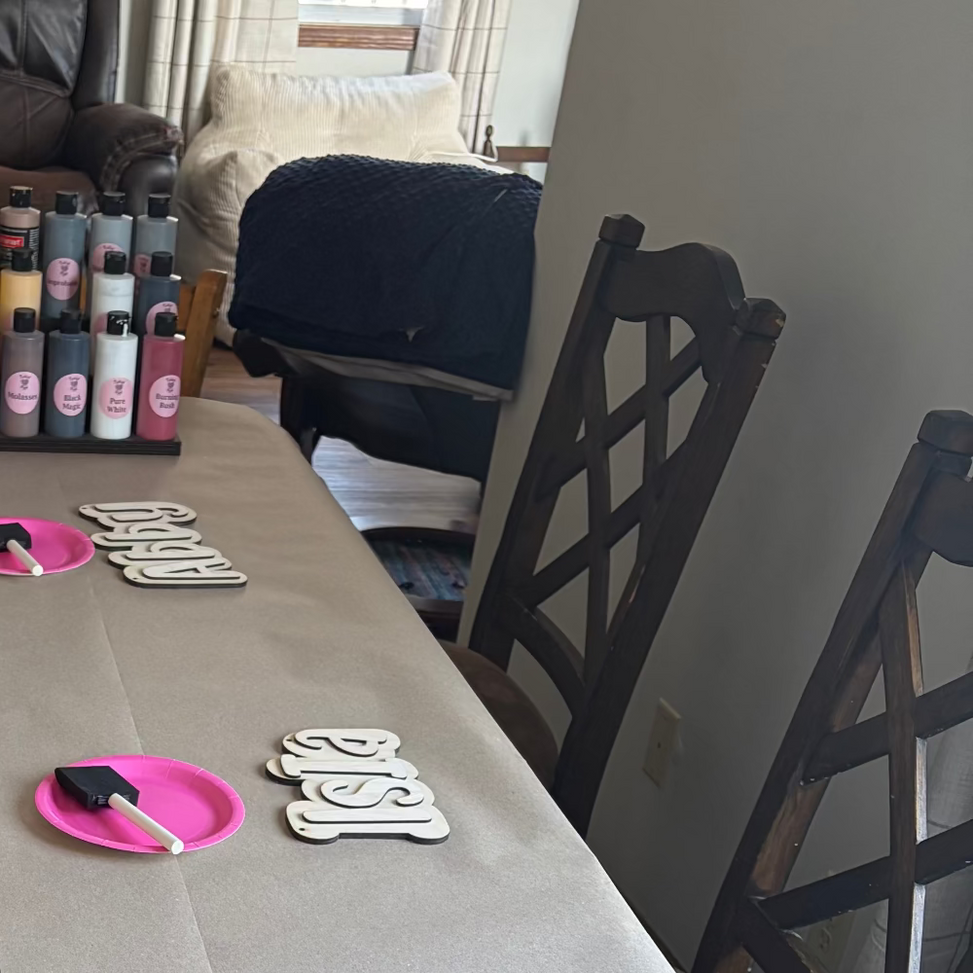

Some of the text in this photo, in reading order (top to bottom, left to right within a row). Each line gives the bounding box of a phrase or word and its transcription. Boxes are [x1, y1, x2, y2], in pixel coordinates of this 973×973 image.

[7, 391, 39, 401] Molasses
[63, 394, 81, 402] Black
[109, 397, 126, 405] Pure
[159, 401, 176, 409] Bush
[106, 405, 127, 413] White
[92, 501, 241, 582] Abby
[278, 727, 435, 827] Isla
